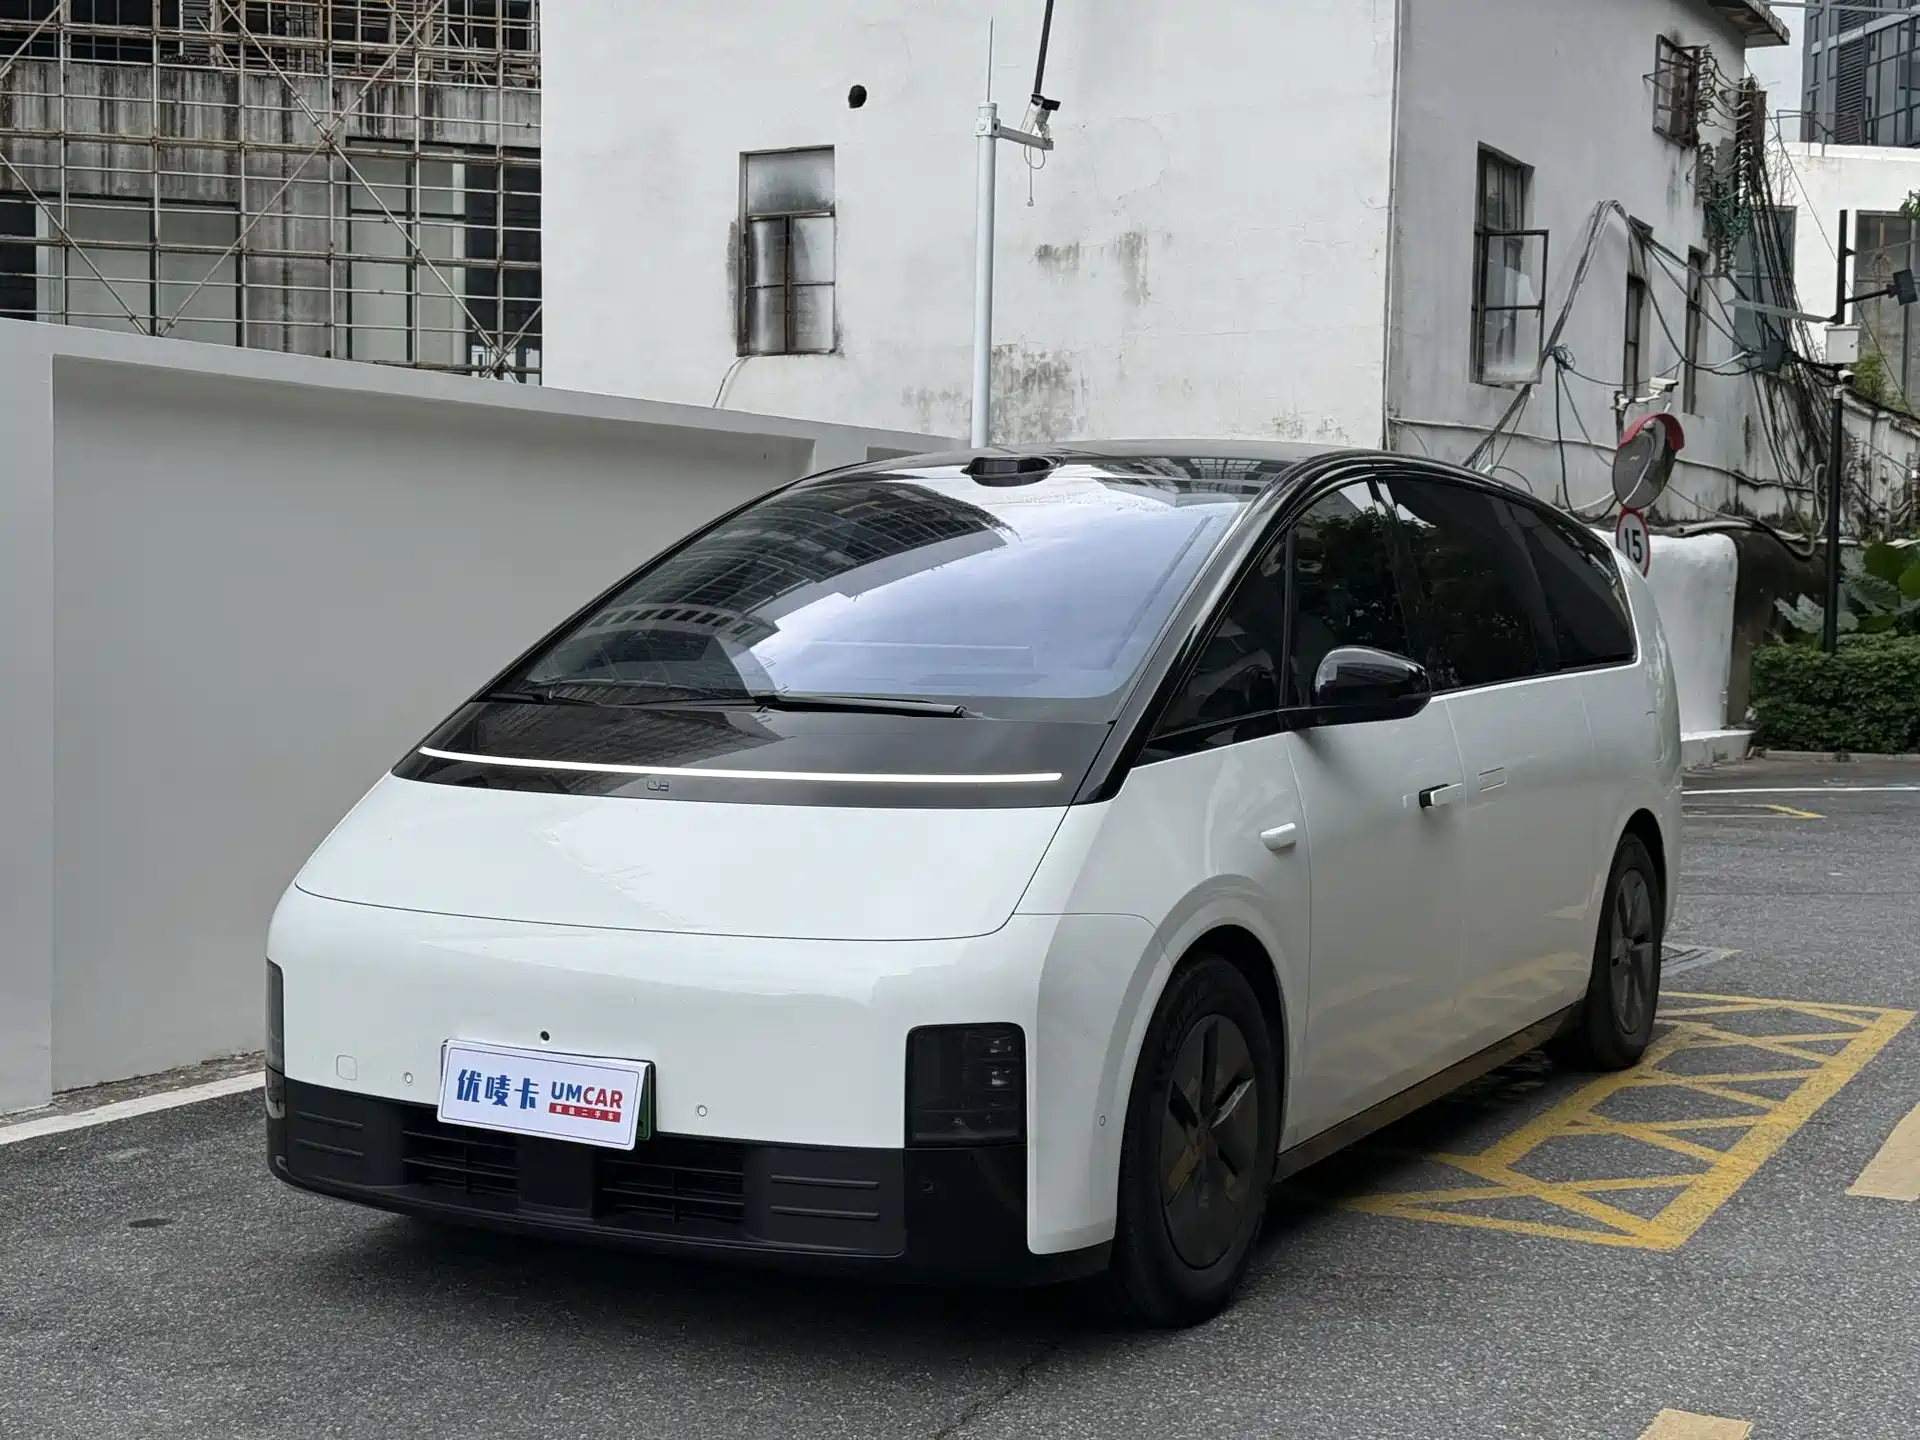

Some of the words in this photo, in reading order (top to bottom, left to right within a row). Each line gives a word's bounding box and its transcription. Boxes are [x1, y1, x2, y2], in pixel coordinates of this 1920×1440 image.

[1625, 528, 1642, 564] 15
[457, 1069, 539, 1109] 优唛卡
[551, 1081, 623, 1109] UMCAR
